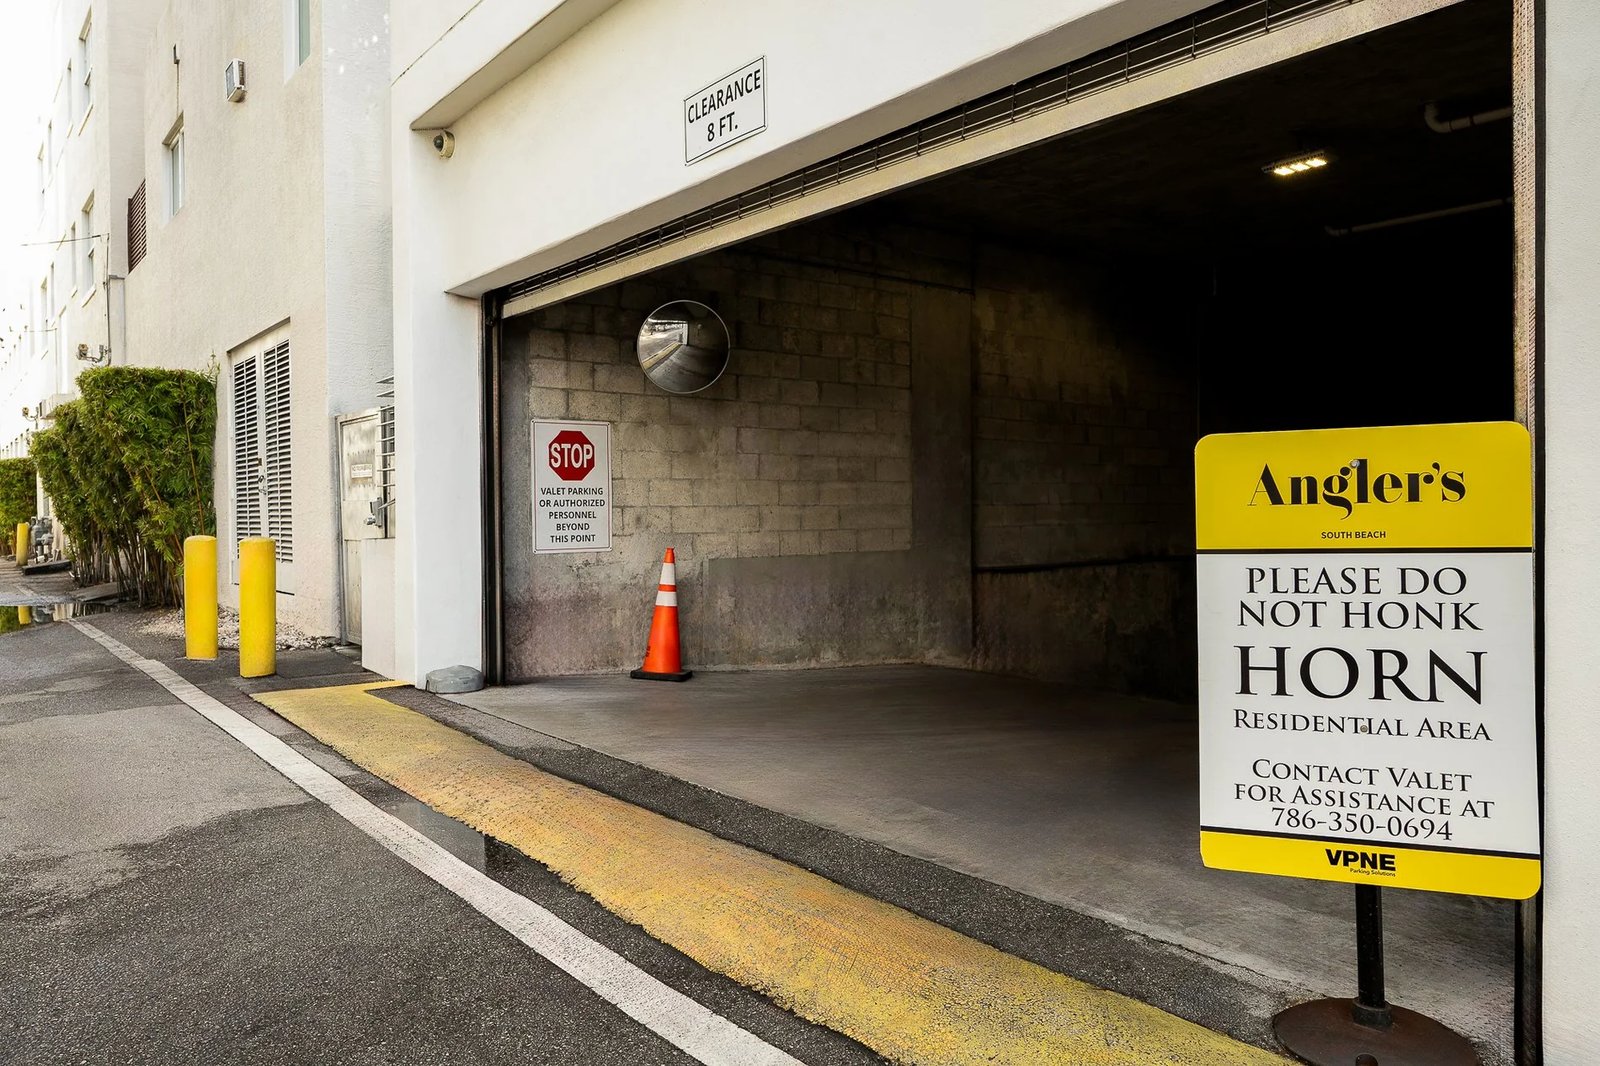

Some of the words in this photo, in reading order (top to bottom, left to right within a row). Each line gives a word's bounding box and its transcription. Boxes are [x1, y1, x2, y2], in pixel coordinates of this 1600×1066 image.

[688, 68, 761, 124] CLEARANCE
[707, 122, 715, 142] 8
[719, 111, 738, 137] FT.
[550, 443, 593, 469] STOP
[540, 487, 566, 496] VALET
[568, 487, 604, 496] PARKING
[1247, 458, 1467, 521] Angler's
[539, 500, 552, 508] OR
[553, 499, 606, 507] AUTHORIZED
[548, 511, 597, 519] PERSONNEL
[550, 535, 568, 543] THIS
[570, 534, 596, 542] POINT
[556, 523, 590, 531] BEYOND
[1321, 531, 1352, 540] SOUTH
[1355, 530, 1386, 539] BEACH
[1245, 567, 1382, 595] PLEASE
[1396, 567, 1468, 596] DO
[1237, 600, 1328, 629] NOT
[1341, 601, 1484, 631] HONK
[1233, 645, 1488, 705] HORN
[1271, 807, 1453, 841] 786-350-0694
[1325, 848, 1396, 872] VPNE
